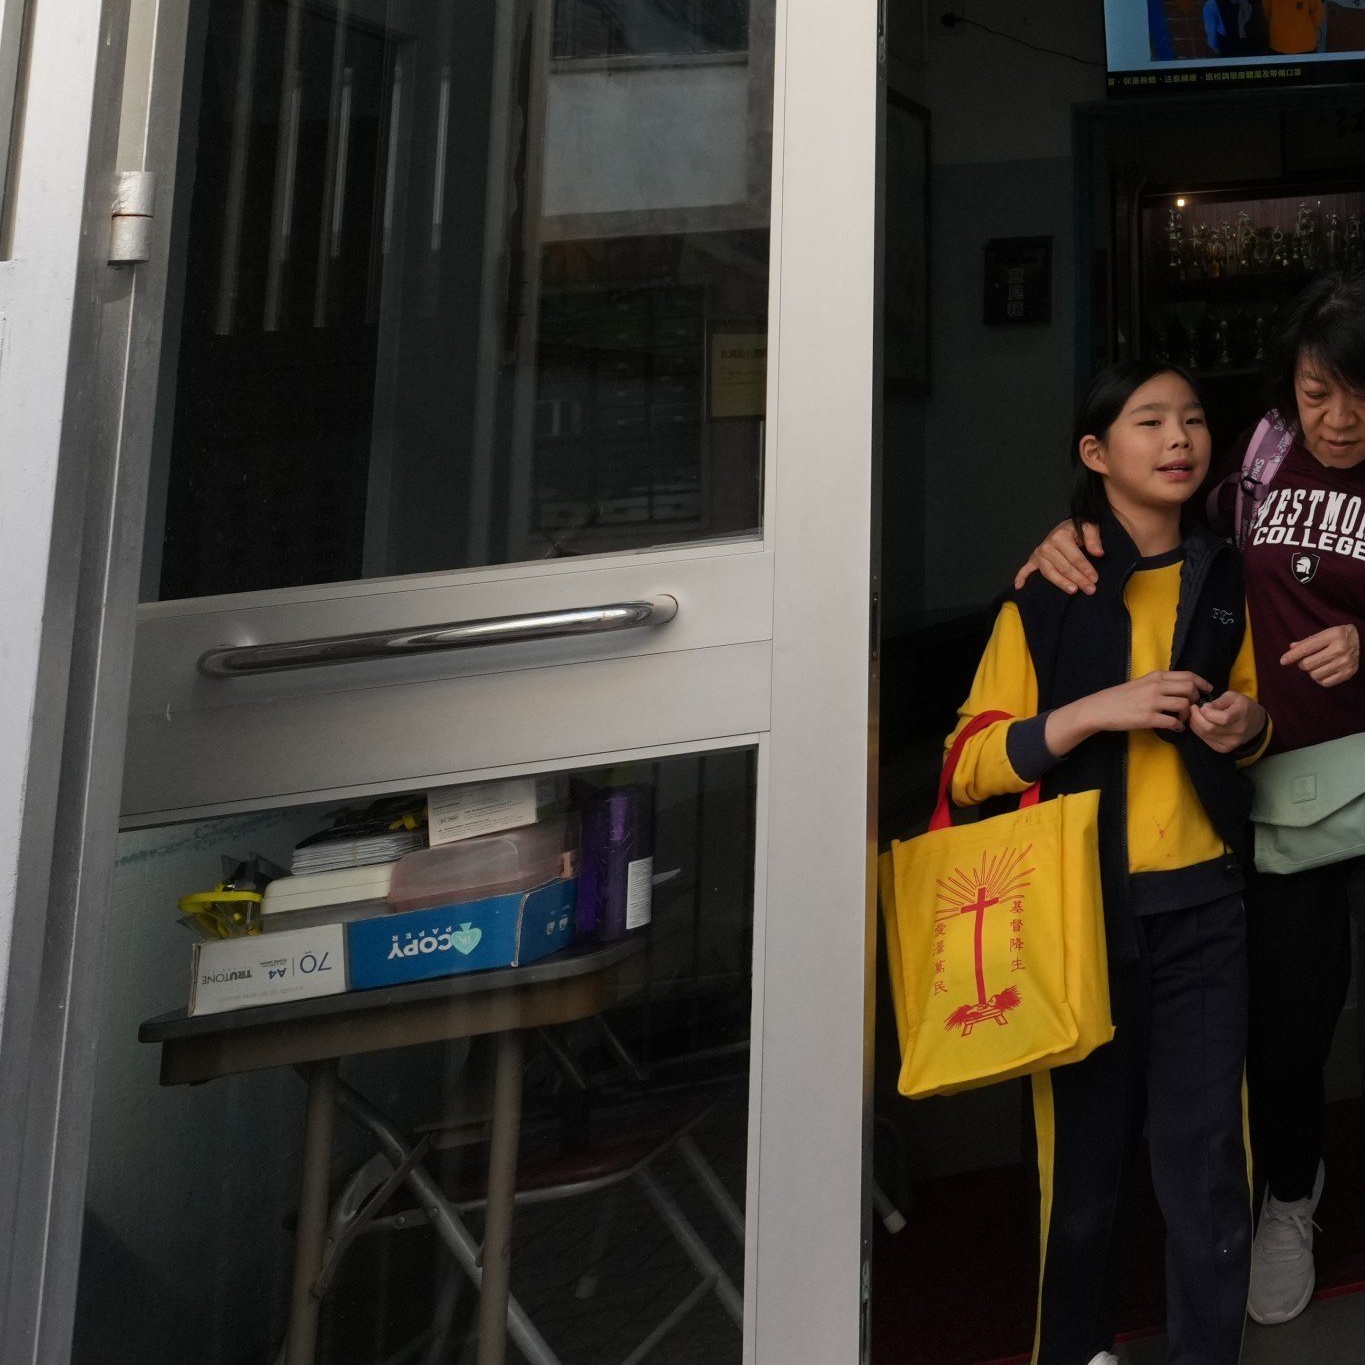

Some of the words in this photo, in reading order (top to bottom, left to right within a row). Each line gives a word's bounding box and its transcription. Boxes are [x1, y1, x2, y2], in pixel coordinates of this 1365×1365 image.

[391, 925, 453, 941] PAPER
[1009, 900, 1026, 973] 基督降生
[386, 933, 453, 960] COPY
[299, 951, 332, 974] 70
[200, 969, 253, 986] TRUTONE
[267, 967, 287, 980] A4
